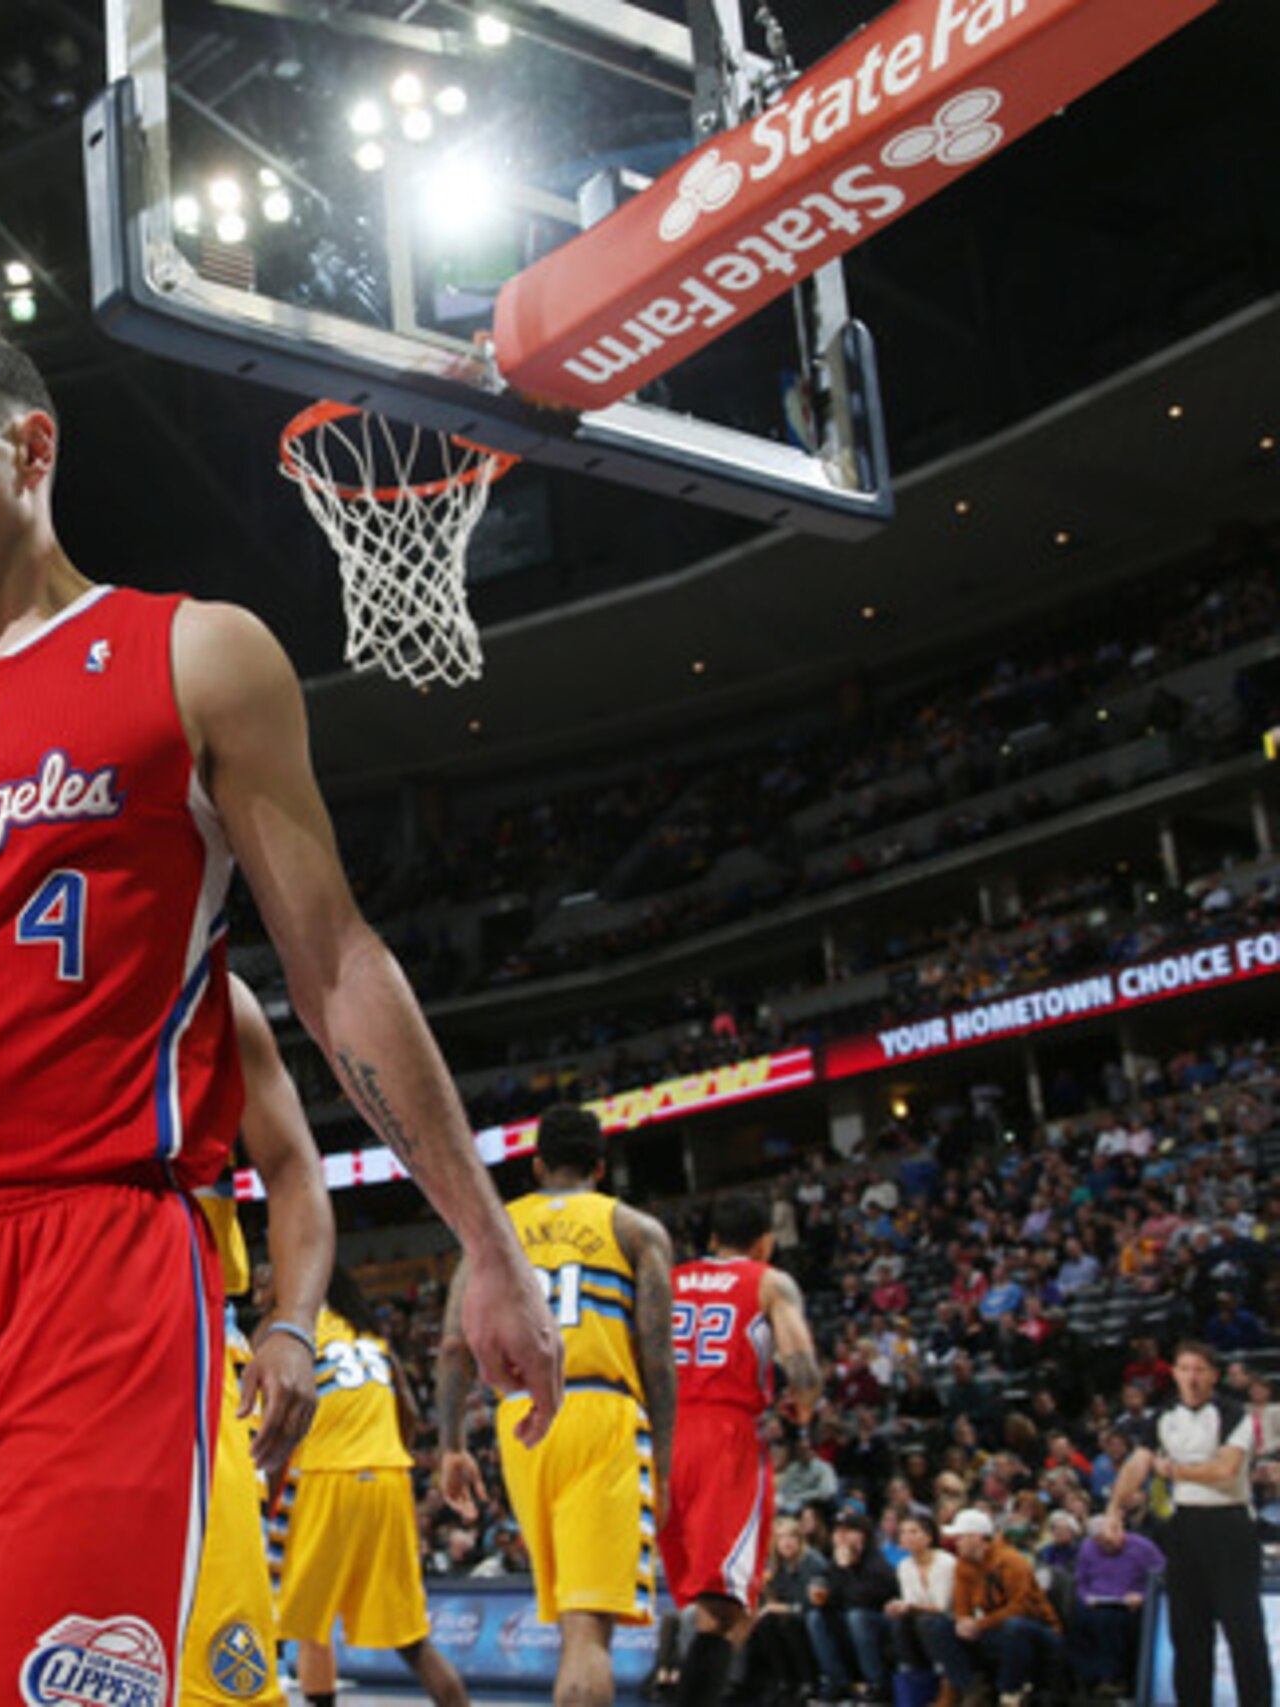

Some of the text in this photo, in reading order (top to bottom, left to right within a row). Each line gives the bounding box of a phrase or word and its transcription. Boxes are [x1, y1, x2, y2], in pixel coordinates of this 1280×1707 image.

[16, 868, 87, 981] 4
[877, 1017, 949, 1059] YOUR
[951, 974, 1113, 1042] HOMETOWN
[1120, 943, 1232, 999] CHOICE
[324, 1338, 392, 1389] 35
[671, 1302, 738, 1368] 22
